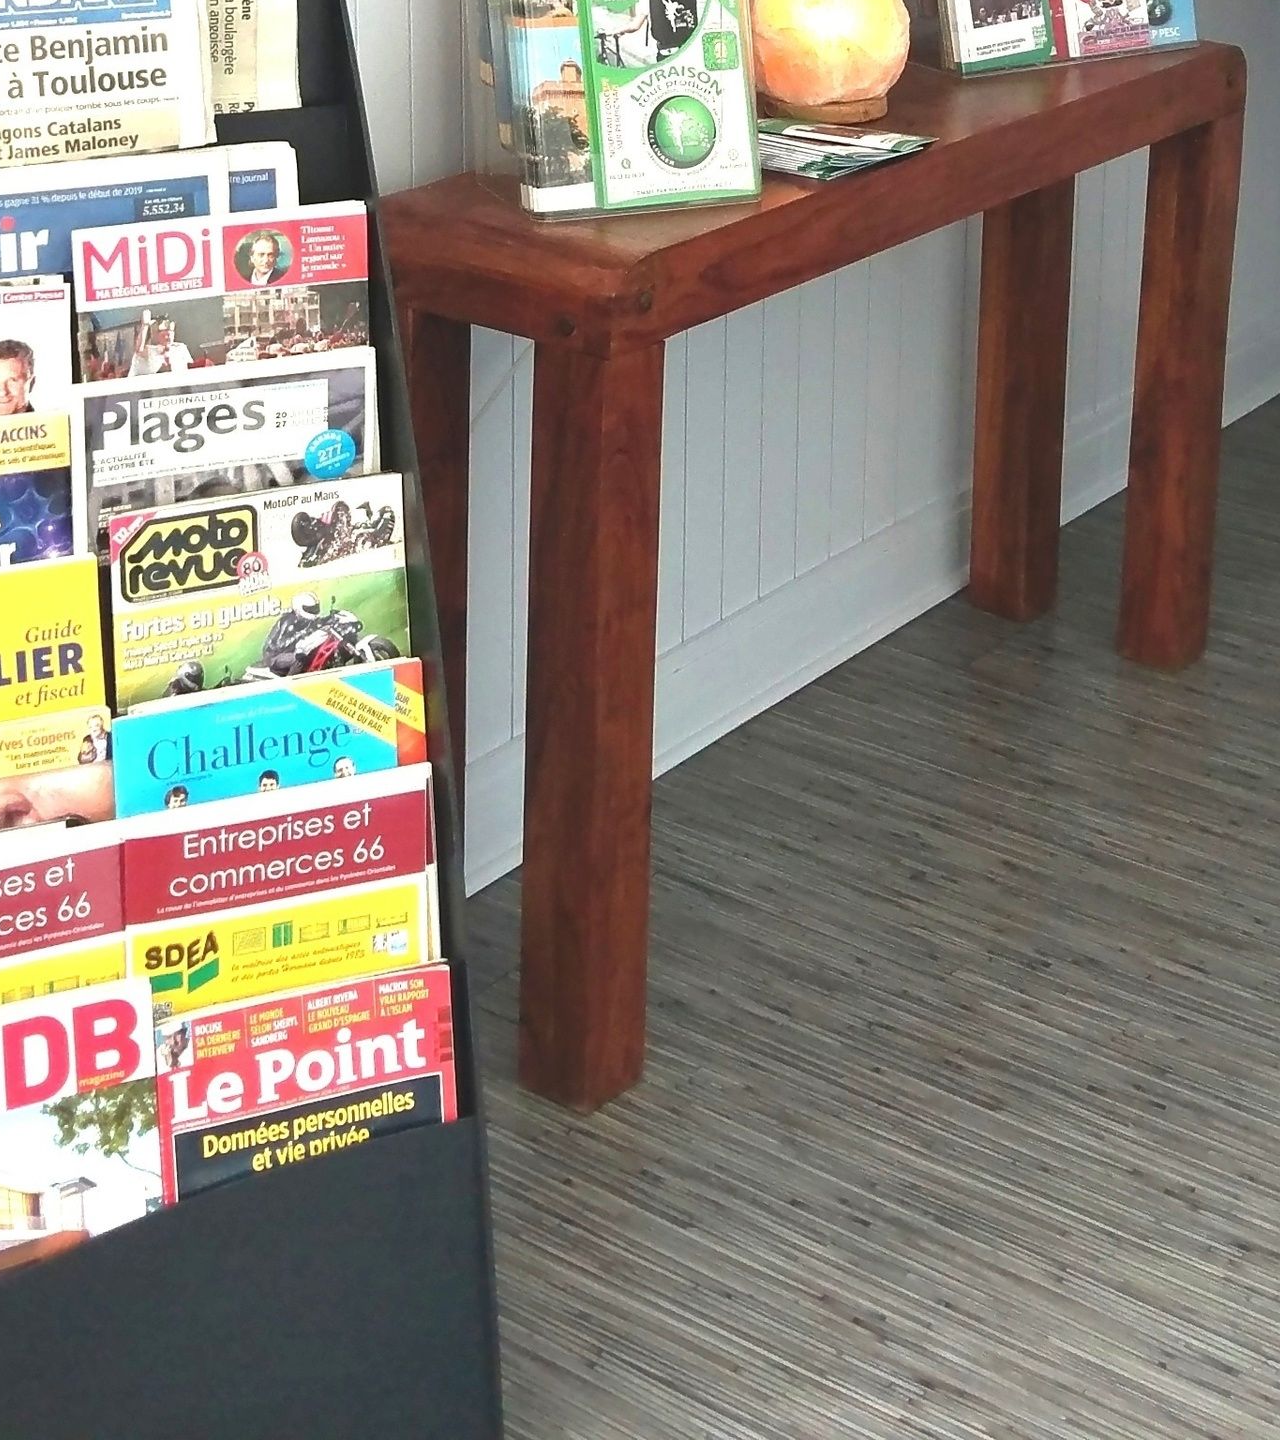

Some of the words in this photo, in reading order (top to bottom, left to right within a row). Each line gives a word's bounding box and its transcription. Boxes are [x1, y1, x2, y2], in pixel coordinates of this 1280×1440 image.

[29, 25, 169, 66] Benjamin
[223, 5, 238, 75] boulangère
[6, 71, 25, 99] à
[32, 66, 168, 98] Toulouse
[630, 66, 724, 103] LIVRAISON
[47, 117, 122, 138] Catalans
[7, 142, 60, 161] James
[64, 133, 140, 155] Maloney
[51, 191, 77, 204] depuis
[78, 189, 87, 200] le
[88, 187, 110, 200] début
[112, 187, 122, 198] de
[101, 396, 267, 454] Plages
[263, 494, 299, 510] MotoGP
[301, 494, 313, 505] au
[314, 489, 340, 503] Mans
[25, 620, 83, 644] Guide
[121, 613, 187, 643] Fortes
[191, 612, 216, 631] en
[15, 689, 34, 707] et
[35, 678, 86, 709] fiscal
[348, 695, 359, 708] SA
[325, 696, 357, 720] BATAILLE
[356, 712, 369, 725] DU
[183, 808, 336, 860] Entreprises
[342, 802, 373, 829] et
[44, 857, 76, 888] et
[168, 847, 345, 898] commerces
[352, 834, 386, 864] 66
[56, 890, 92, 924] 66
[144, 929, 220, 972] SDEA
[378, 980, 408, 995] MACRON
[379, 992, 395, 1006] VRAI
[396, 987, 430, 1003] RAPPORT
[77, 1068, 126, 1088] magazine
[169, 1069, 245, 1124] Le
[254, 1016, 427, 1106] Point
[203, 1122, 290, 1159] Données
[293, 1090, 416, 1141] personnelles
[252, 1149, 274, 1172] et
[275, 1141, 306, 1165] vie
[309, 1126, 370, 1158] privée
